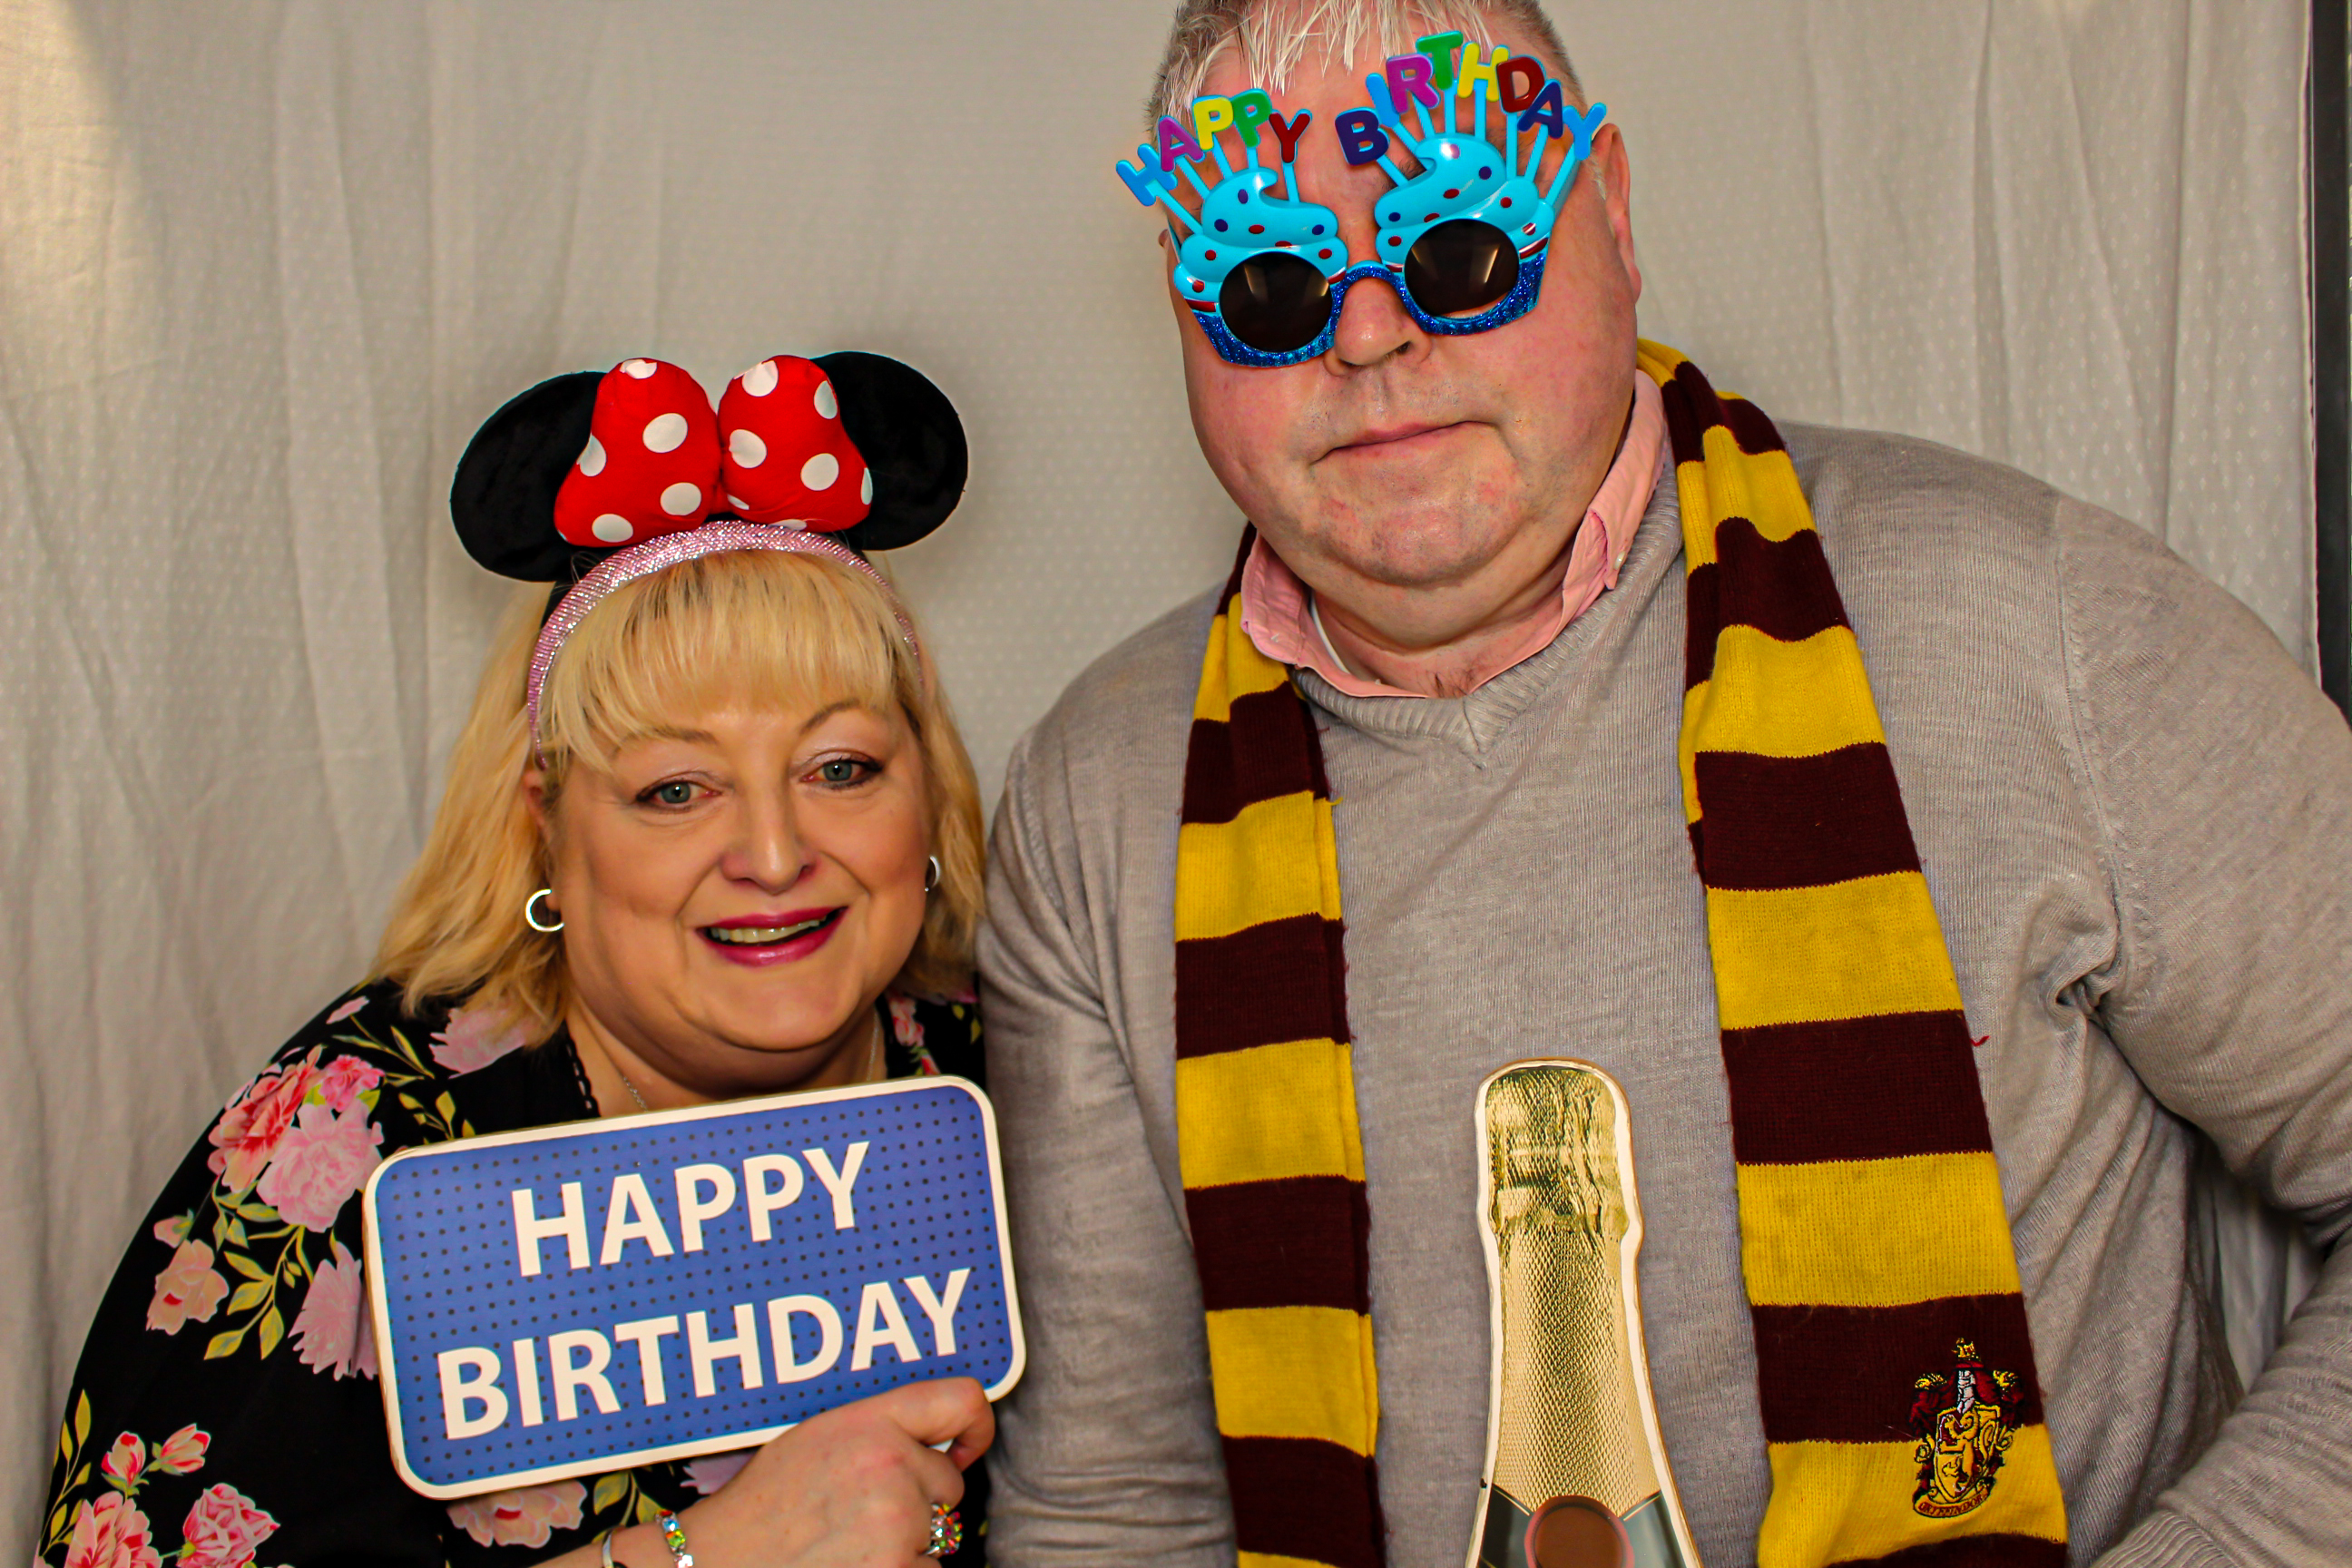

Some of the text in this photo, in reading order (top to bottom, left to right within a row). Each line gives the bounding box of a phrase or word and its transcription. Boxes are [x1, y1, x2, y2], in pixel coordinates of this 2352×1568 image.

[1116, 31, 1607, 206] HAPPY BIRTHDAY
[512, 1141, 869, 1277] HAPPY
[436, 1268, 971, 1440] BIRTHDAY
